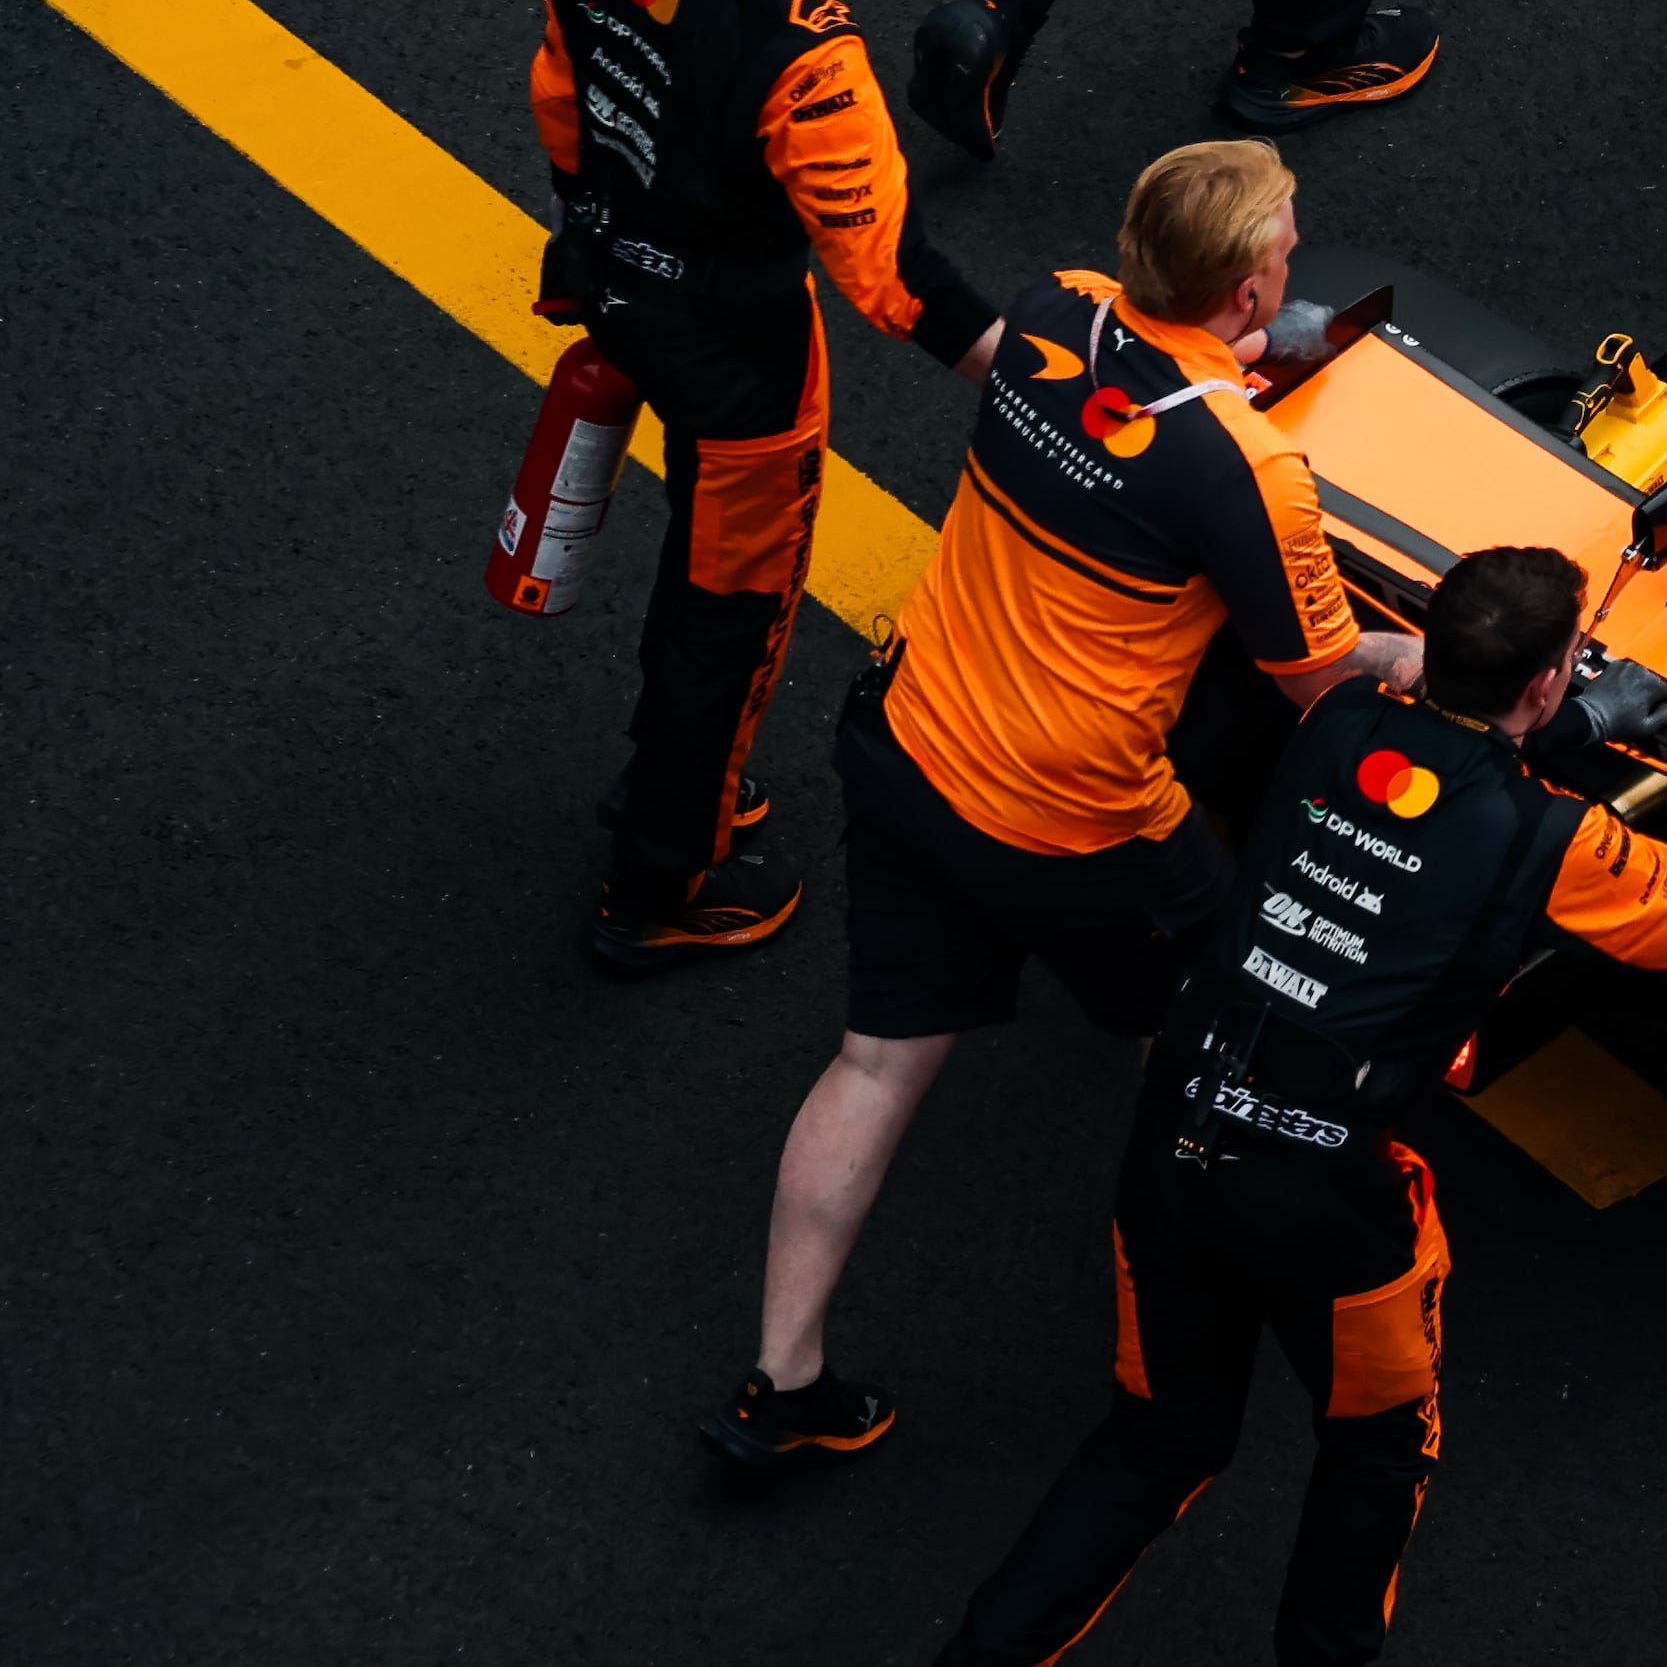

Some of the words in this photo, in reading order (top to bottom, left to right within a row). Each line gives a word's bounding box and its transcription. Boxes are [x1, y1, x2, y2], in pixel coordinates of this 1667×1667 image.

[993, 397, 1044, 450] FORMULA
[1060, 458, 1096, 490] TEAM
[1040, 421, 1124, 490] MASTERCARD
[1325, 811, 1353, 839] DP
[1353, 826, 1423, 874] WORLD
[1291, 850, 1357, 902] Android
[1306, 927, 1369, 966] NUTRITION
[1311, 915, 1367, 951] OPTIMUM
